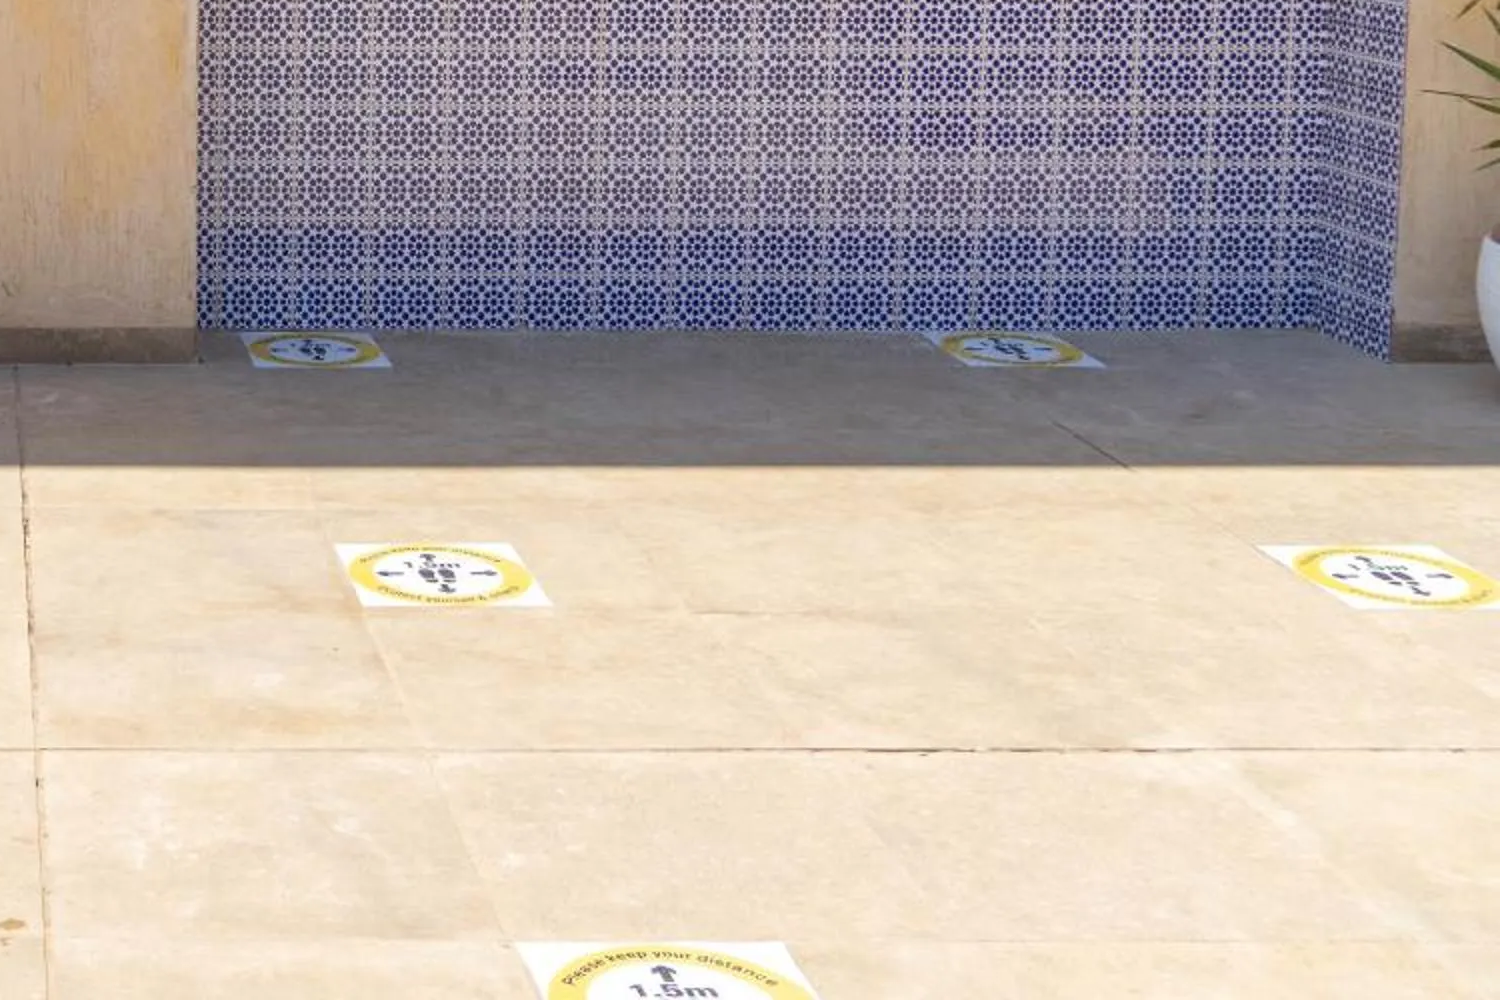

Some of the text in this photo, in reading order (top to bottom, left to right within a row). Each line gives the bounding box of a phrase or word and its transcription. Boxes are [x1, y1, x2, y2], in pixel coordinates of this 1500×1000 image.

[604, 951, 647, 962] keep
[651, 951, 690, 960] your
[697, 955, 779, 987] distance
[628, 983, 719, 998] 1.5m
